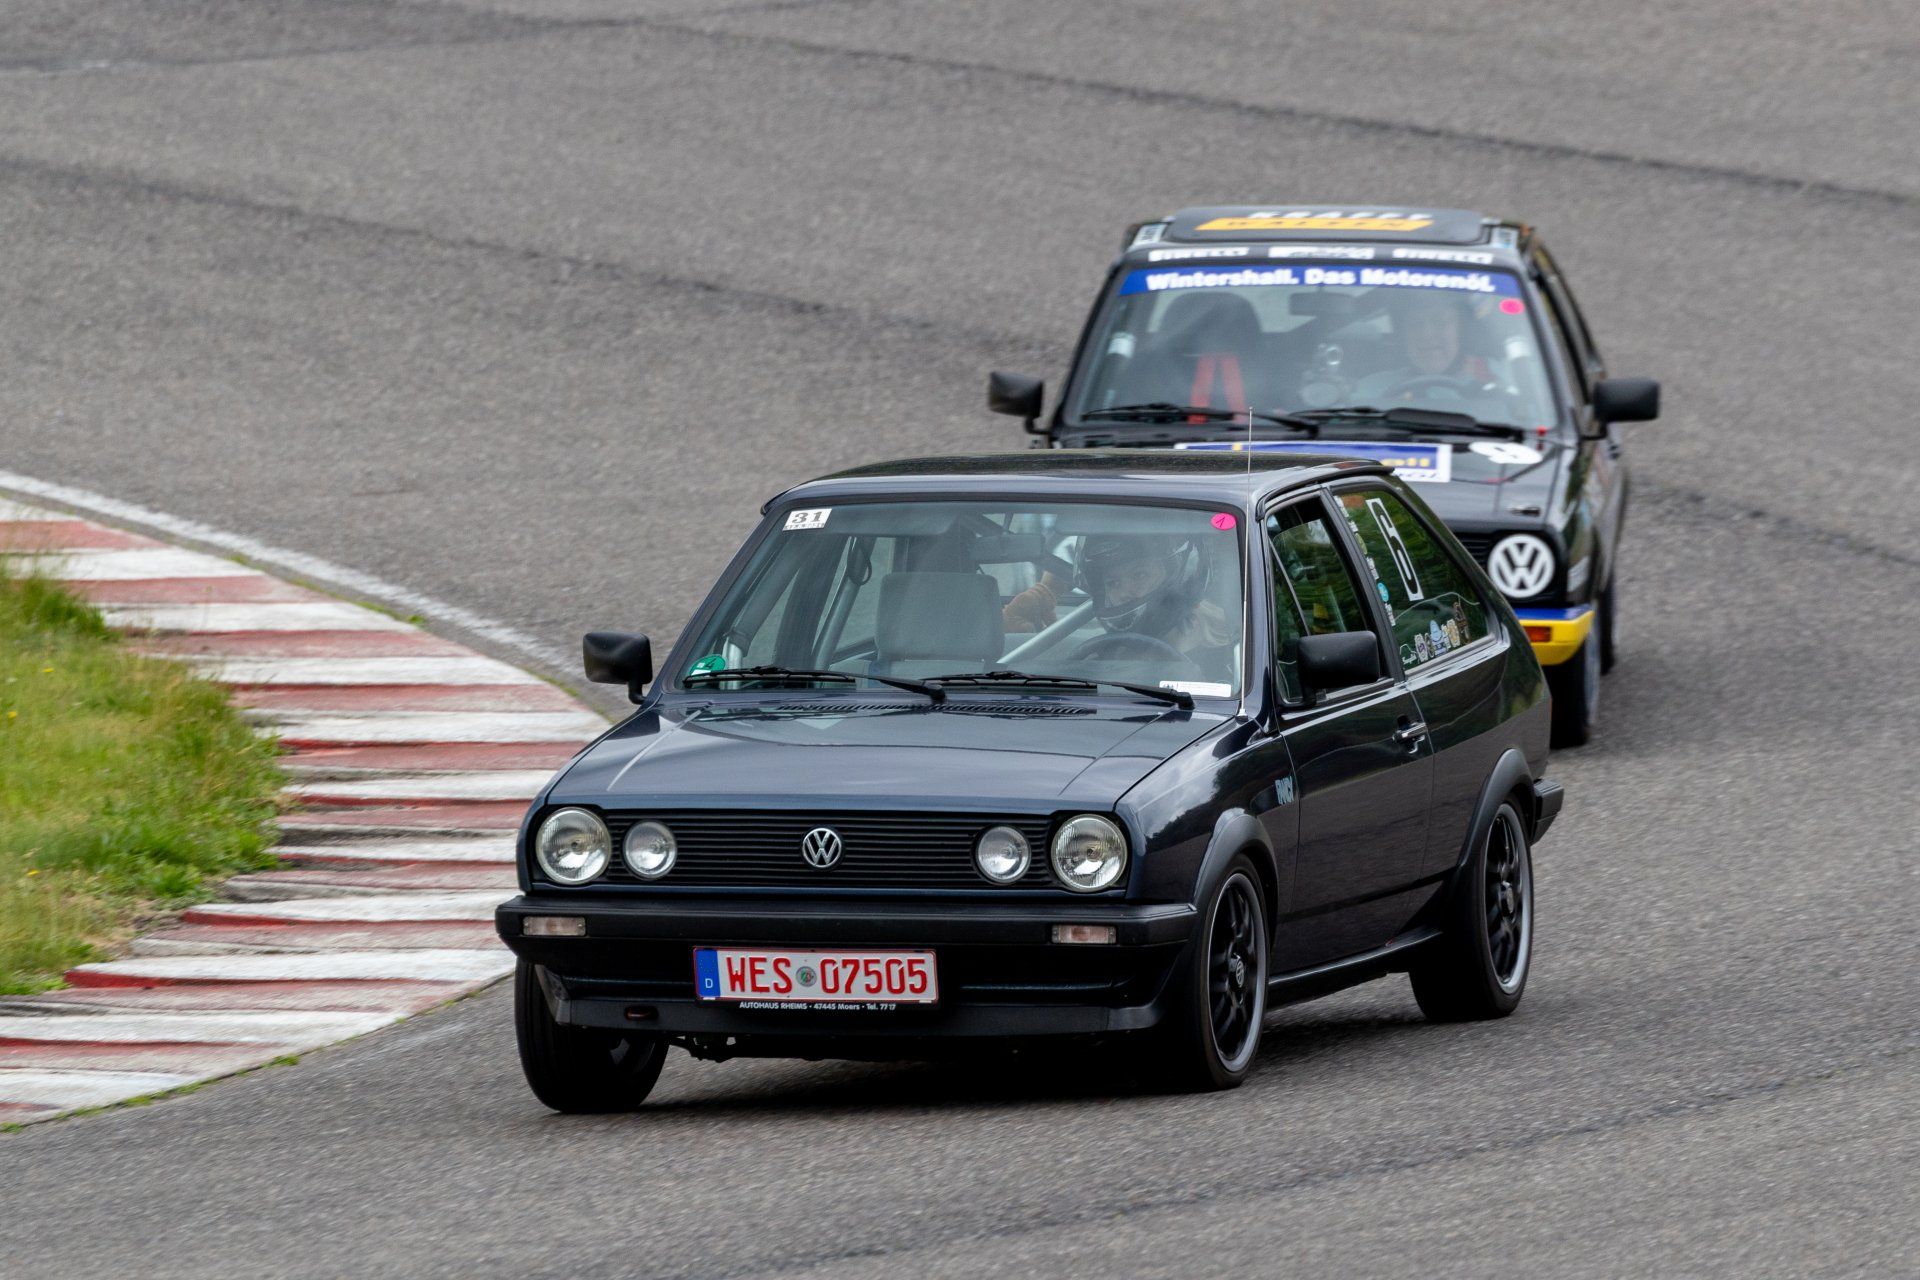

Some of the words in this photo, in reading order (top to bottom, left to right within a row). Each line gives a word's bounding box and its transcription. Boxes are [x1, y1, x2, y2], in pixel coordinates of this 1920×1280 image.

[1304, 268, 1356, 285] Das
[791, 511, 823, 524] 31
[1488, 533, 1555, 598] VW
[705, 657, 717, 669] 4
[802, 828, 842, 867] VW
[704, 977, 714, 989] D
[726, 956, 793, 994] WES
[819, 958, 928, 995] 07505
[739, 1001, 779, 1010] AUTOHAUS
[813, 1003, 836, 1011] 47445
[837, 1003, 860, 1011] Moers
